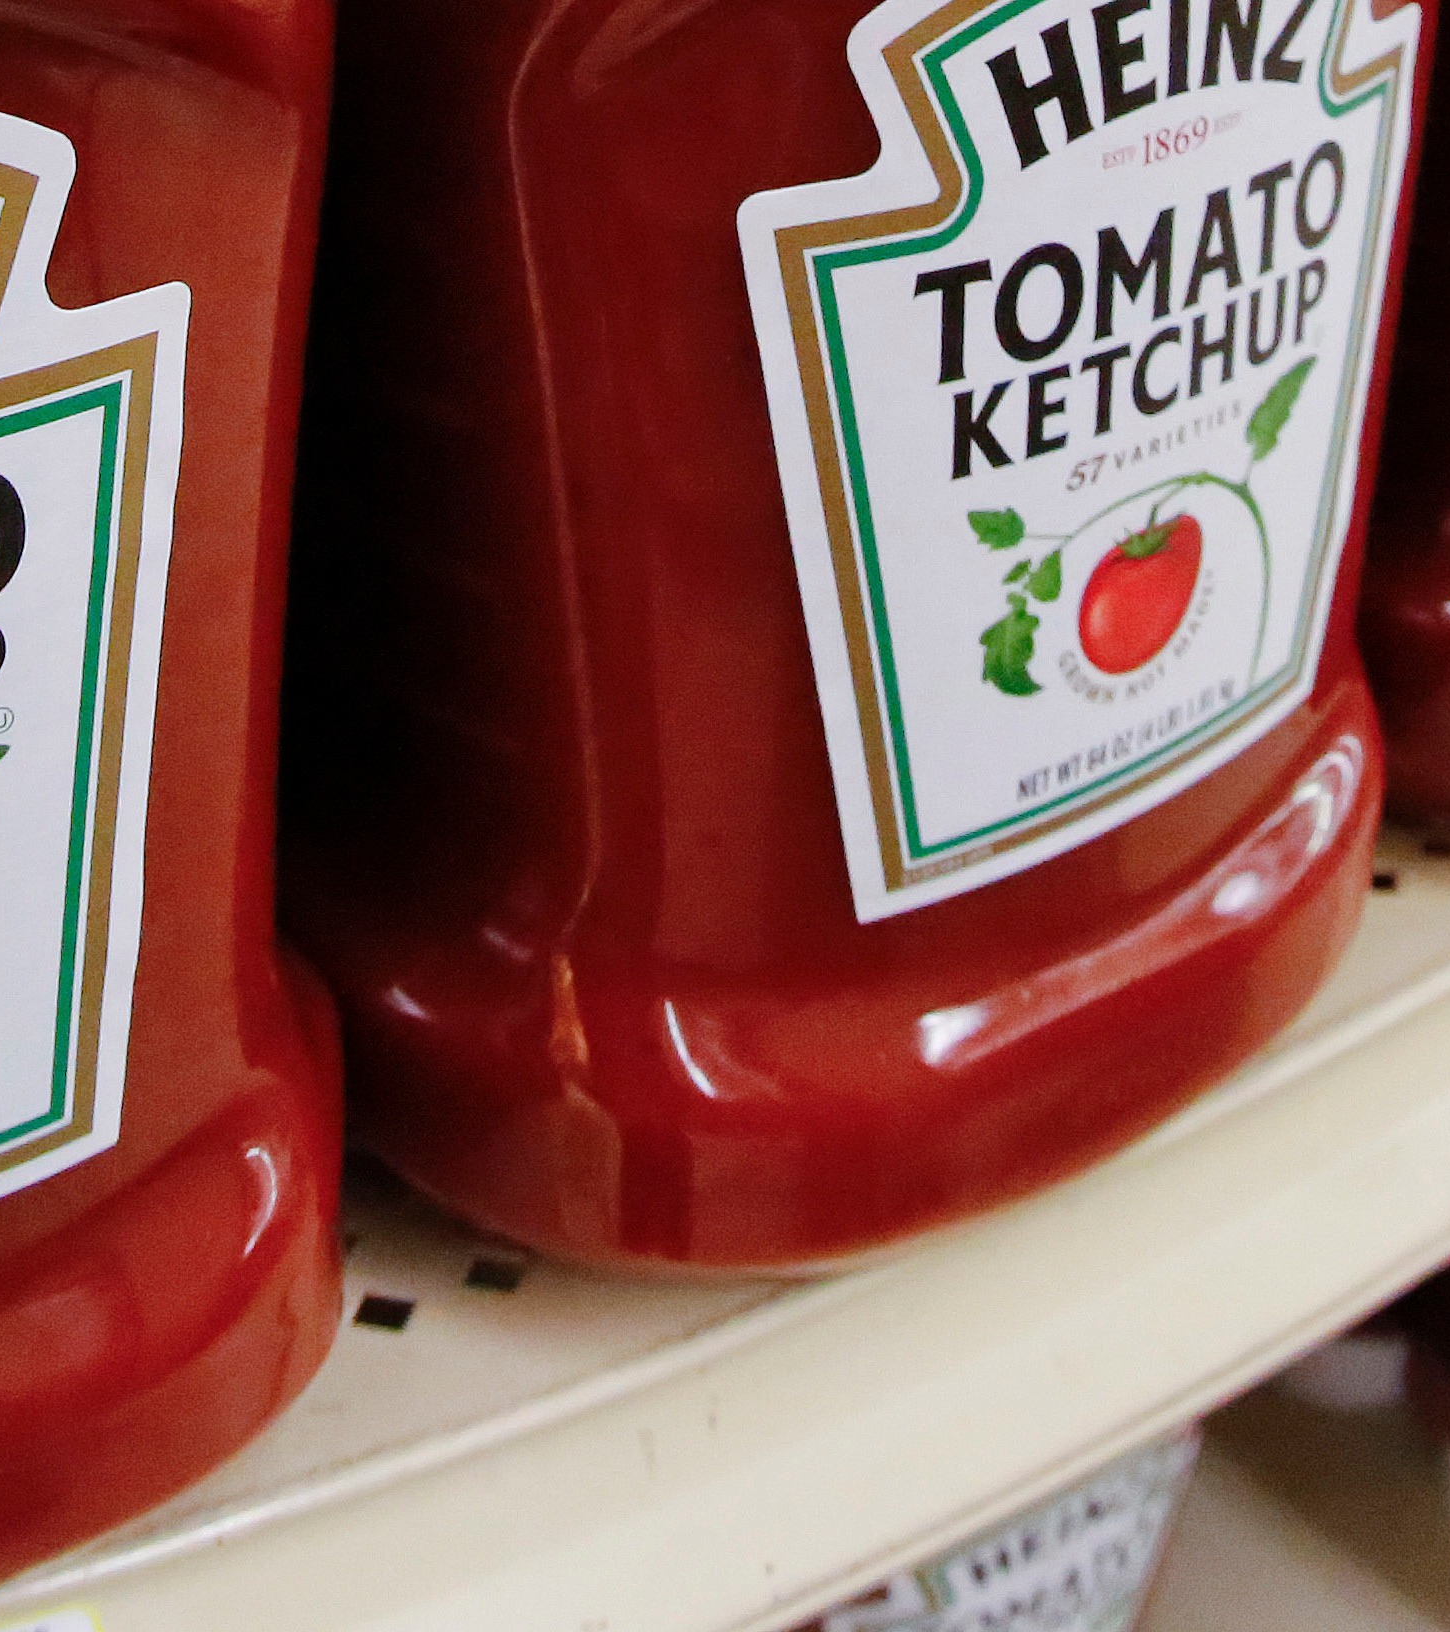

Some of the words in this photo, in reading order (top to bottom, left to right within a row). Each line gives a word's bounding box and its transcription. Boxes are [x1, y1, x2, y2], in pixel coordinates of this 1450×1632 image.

[1142, 115, 1209, 166] 1869
[913, 140, 1346, 385] TOMATO
[949, 258, 1327, 481] KETCHUP
[1065, 453, 1107, 491] 57
[1113, 399, 1242, 470] VARIETIES
